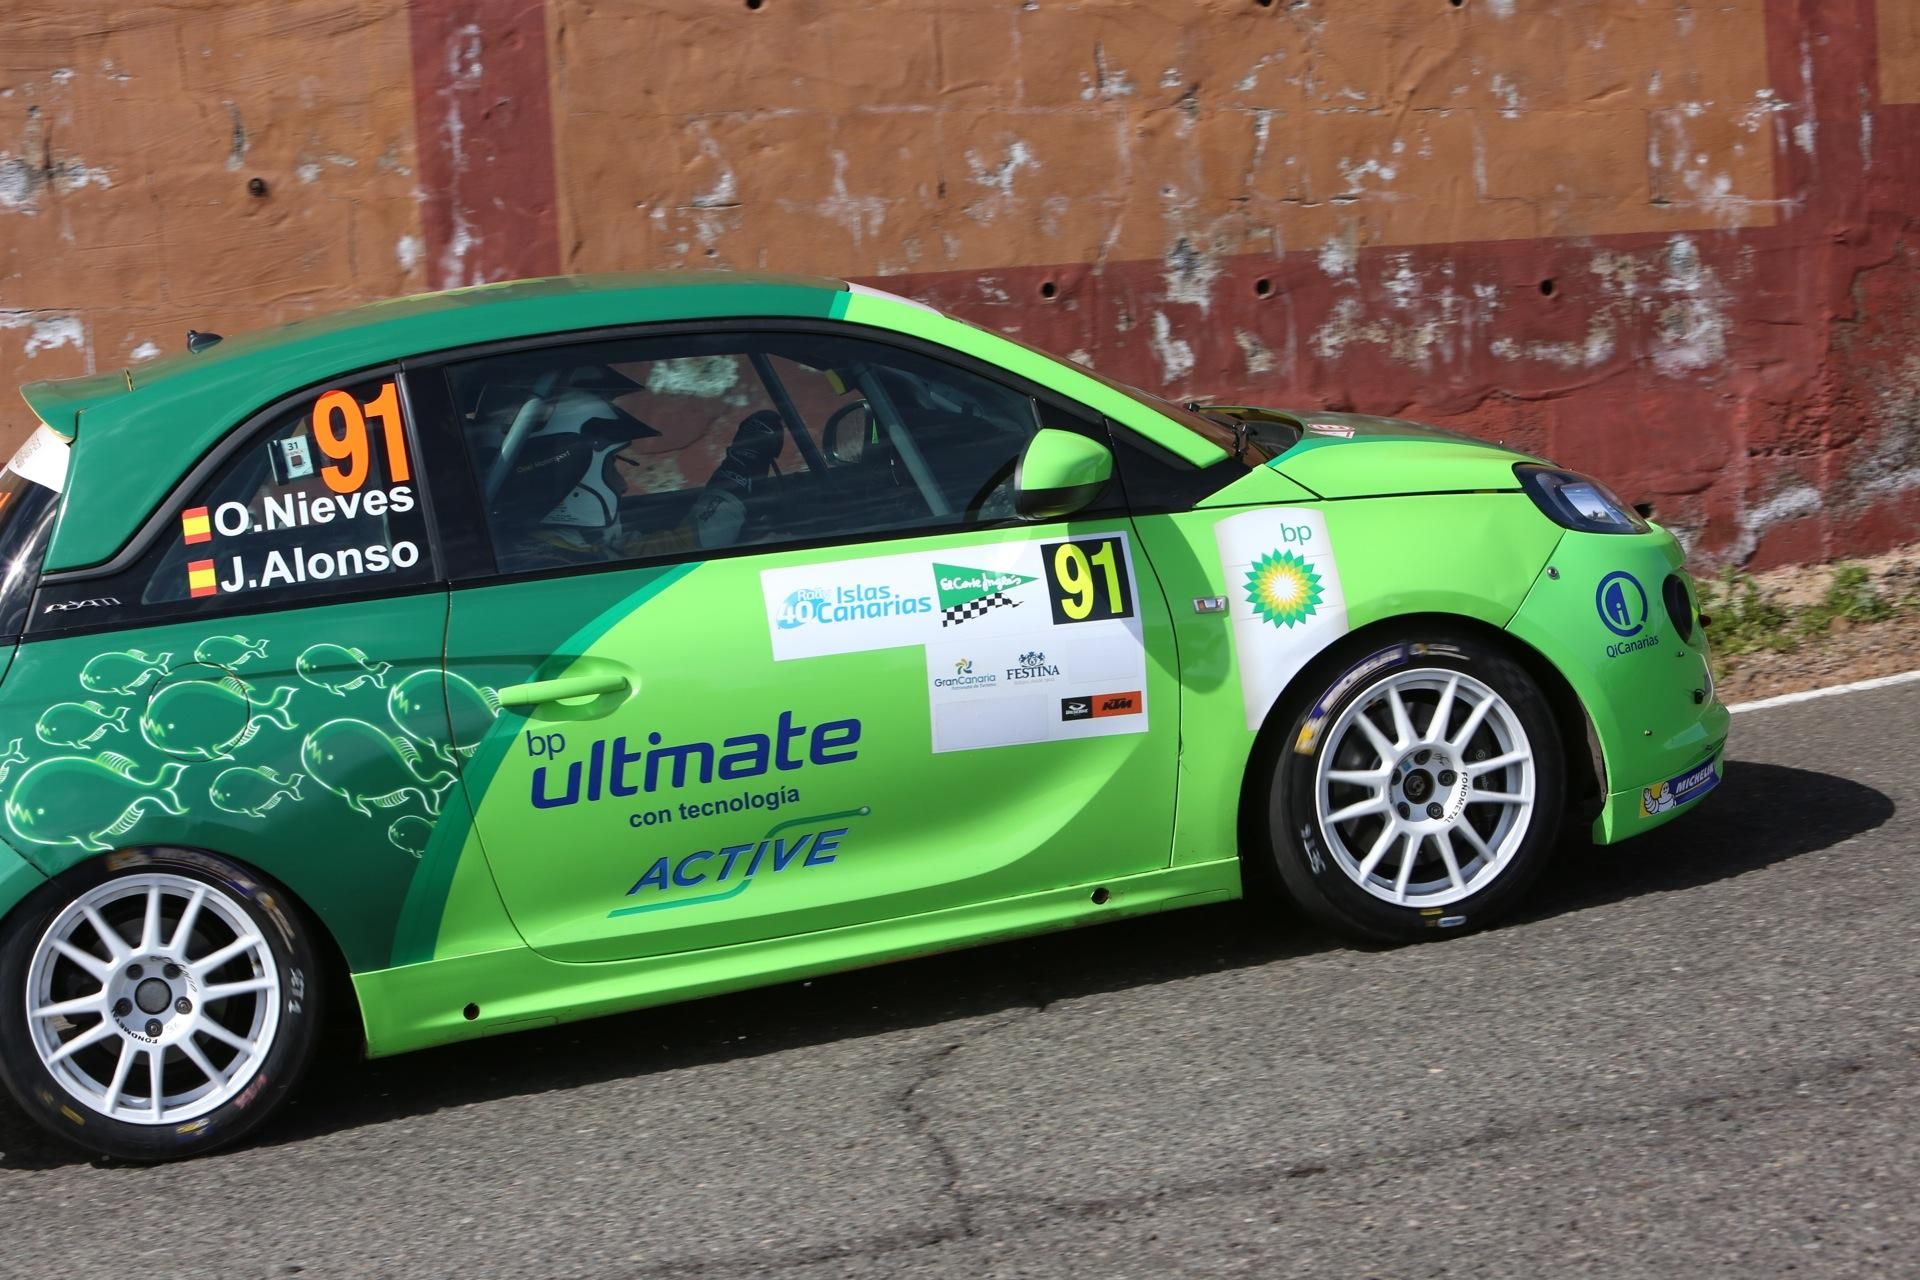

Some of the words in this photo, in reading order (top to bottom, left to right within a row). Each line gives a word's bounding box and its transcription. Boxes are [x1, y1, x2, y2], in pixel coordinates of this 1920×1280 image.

[287, 441, 298, 451] 31
[312, 383, 410, 493] 91
[214, 486, 414, 537] O.Nieves
[1280, 523, 1312, 546] bp
[221, 541, 419, 593] J.Alonso
[1054, 541, 1123, 620] 91
[837, 583, 890, 604] Islas
[776, 601, 817, 625] 40
[817, 594, 932, 624] Canarias
[1605, 633, 1660, 660] QiCanarias
[934, 673, 996, 688] GranCanaria
[1006, 665, 1060, 681] FESTINA
[1102, 698, 1132, 711] KTM
[526, 730, 566, 760] bp
[530, 710, 862, 810] ultimate
[628, 808, 673, 828] con
[678, 785, 801, 821] tecnología
[1444, 771, 1468, 823] FONDMETAL
[625, 827, 849, 897] ACTIVE
